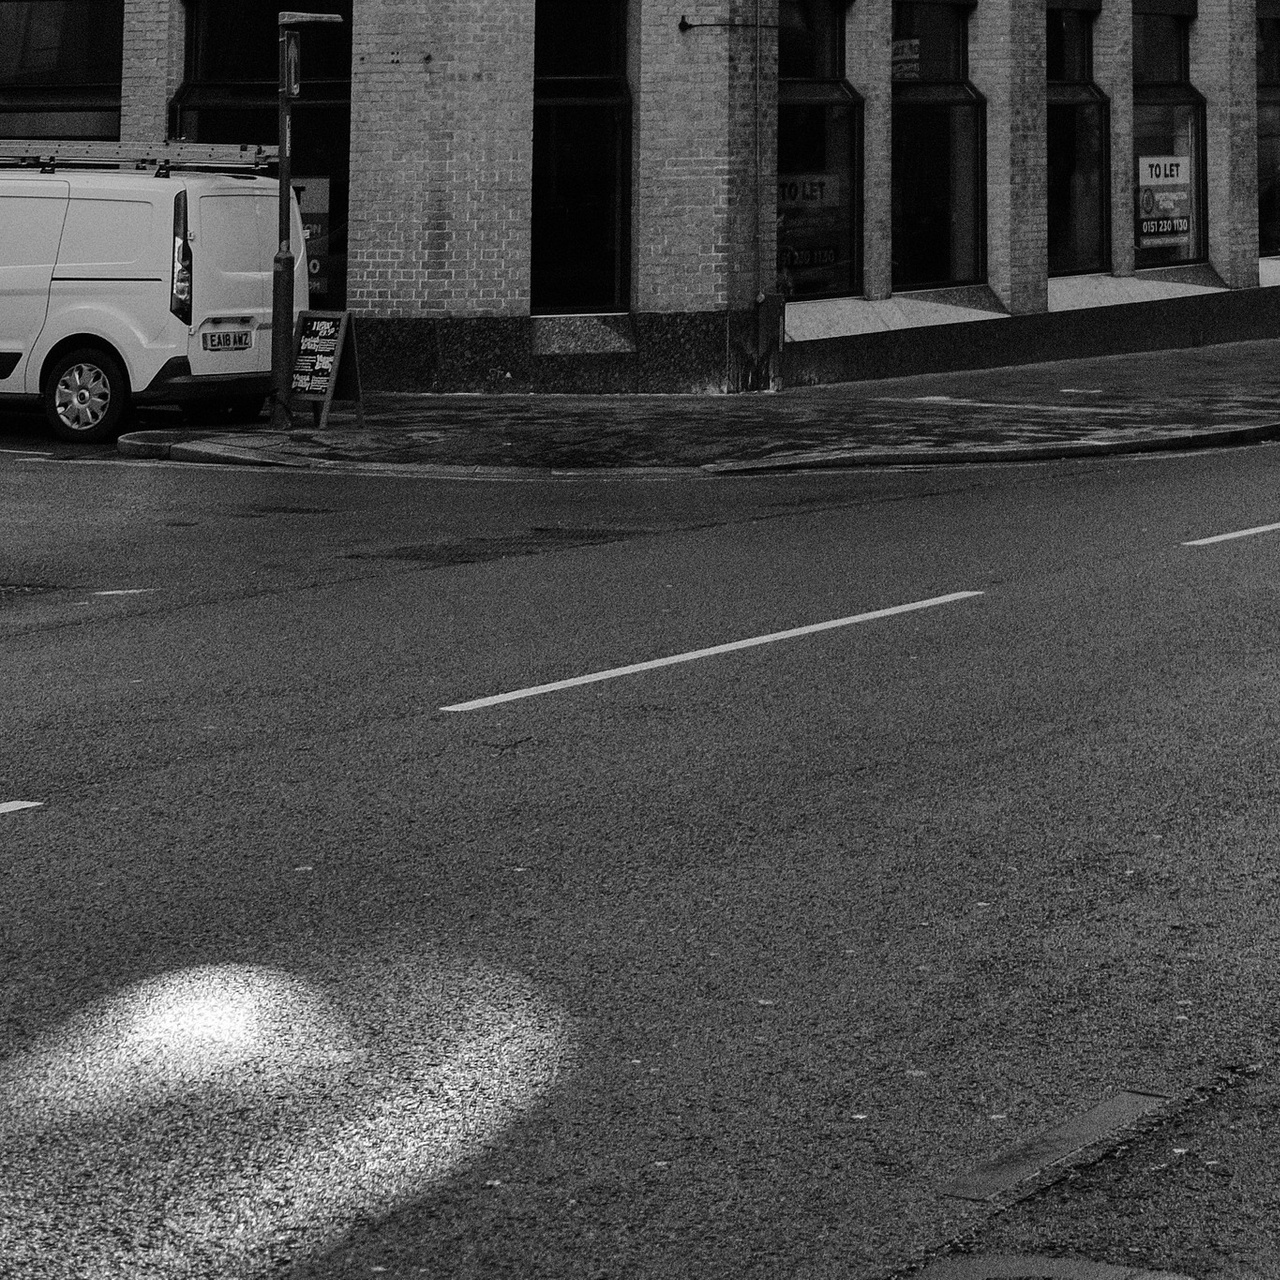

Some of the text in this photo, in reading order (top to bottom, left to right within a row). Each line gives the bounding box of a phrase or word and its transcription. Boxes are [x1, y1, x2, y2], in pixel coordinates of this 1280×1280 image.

[1148, 162, 1180, 179] TO LET
[779, 181, 826, 201] TO LET
[1142, 219, 1188, 233] 0151 230 1130
[210, 333, 231, 347] EA18
